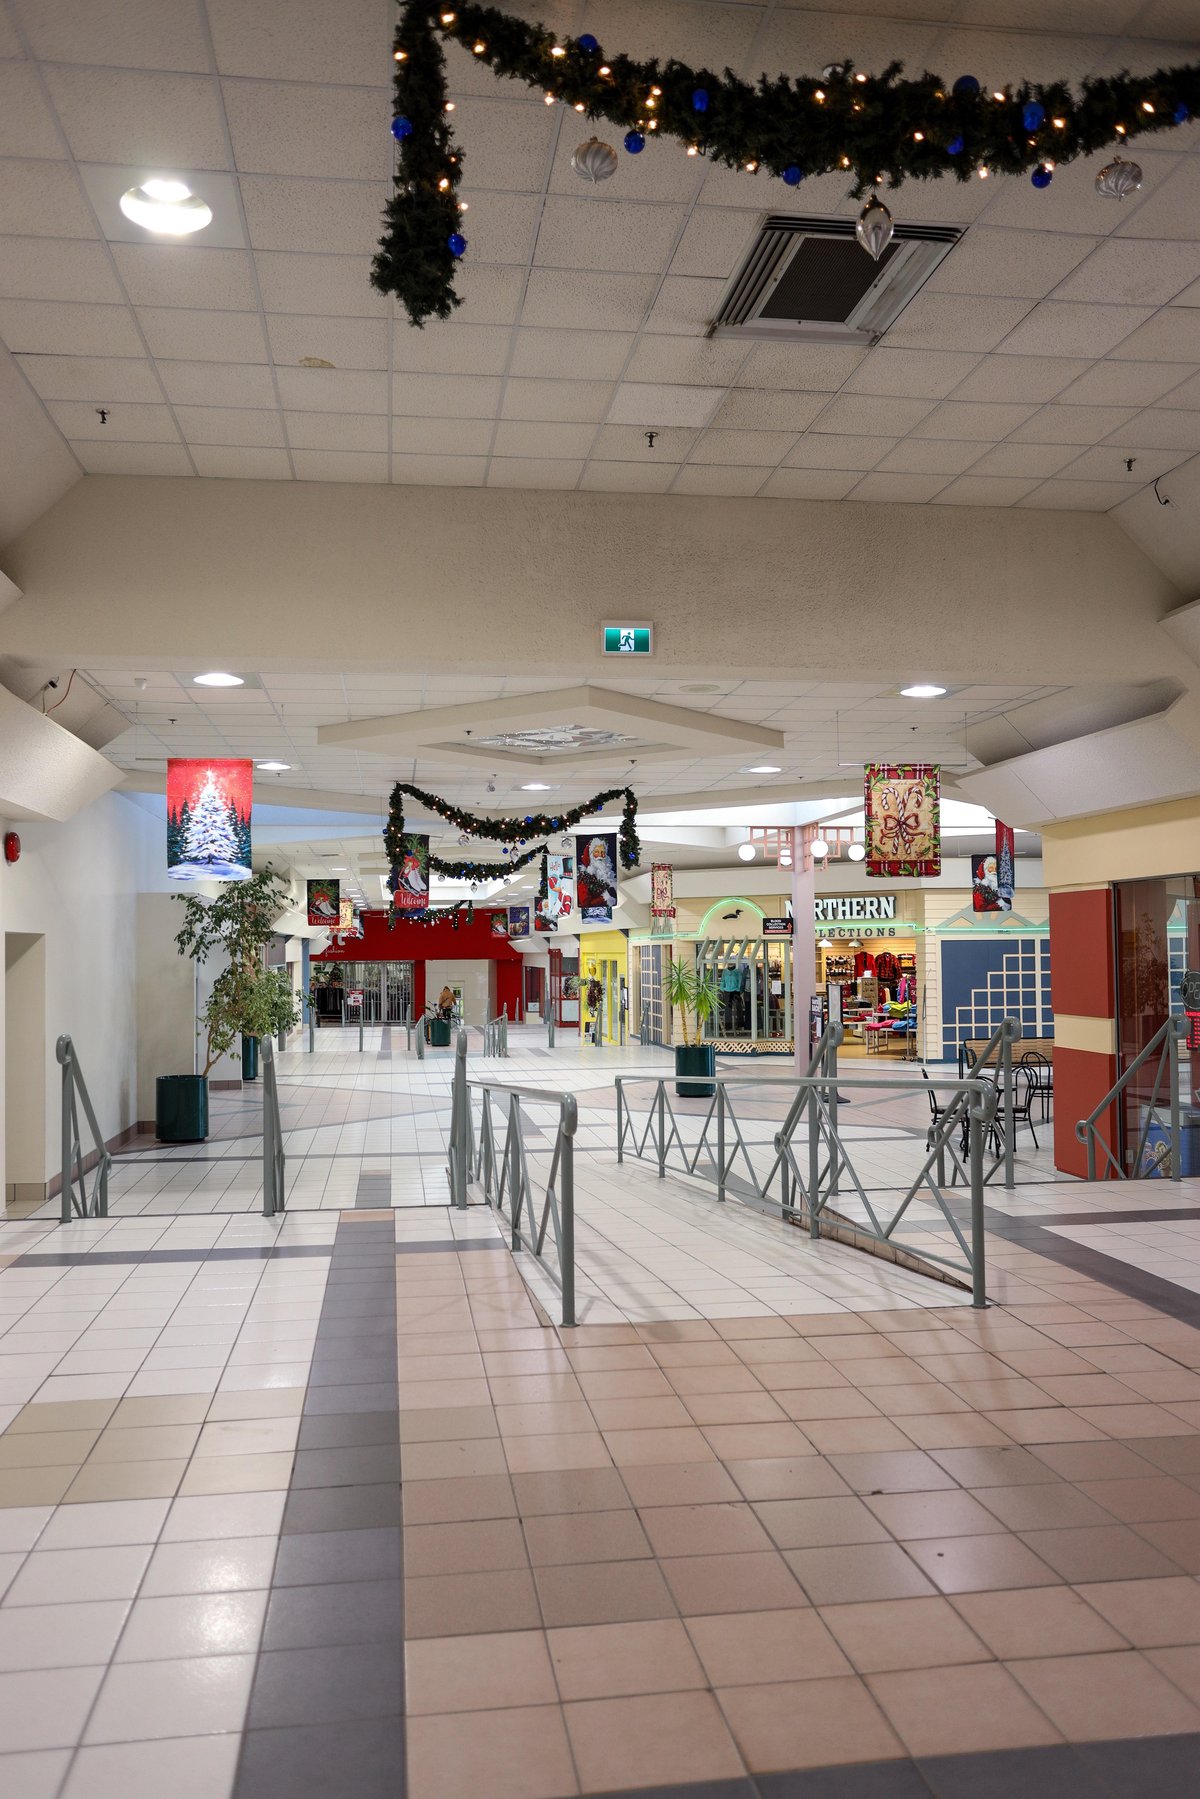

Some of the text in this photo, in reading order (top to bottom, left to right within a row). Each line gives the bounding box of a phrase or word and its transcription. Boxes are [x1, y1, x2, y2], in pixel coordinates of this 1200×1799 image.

[400, 893, 426, 906] Welcome
[784, 896, 895, 920] NRTHERN
[311, 916, 336, 926] Welcome
[815, 927, 896, 938] LECTIONS
